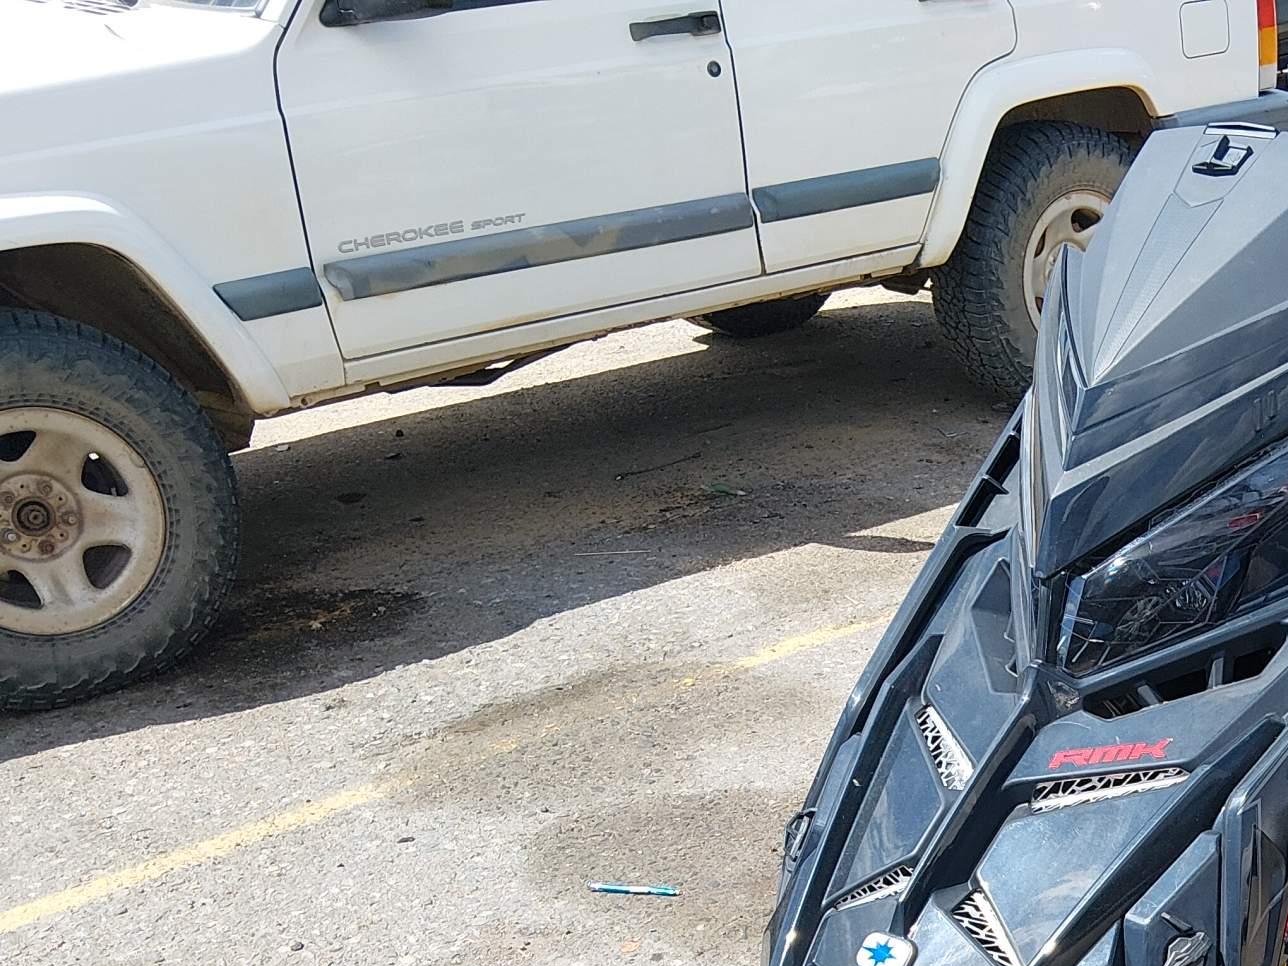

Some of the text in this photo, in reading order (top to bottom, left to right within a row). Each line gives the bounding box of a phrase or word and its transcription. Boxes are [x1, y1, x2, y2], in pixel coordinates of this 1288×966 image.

[337, 212, 526, 254] CHEROKEE SPORT
[1048, 736, 1174, 770] RMK
